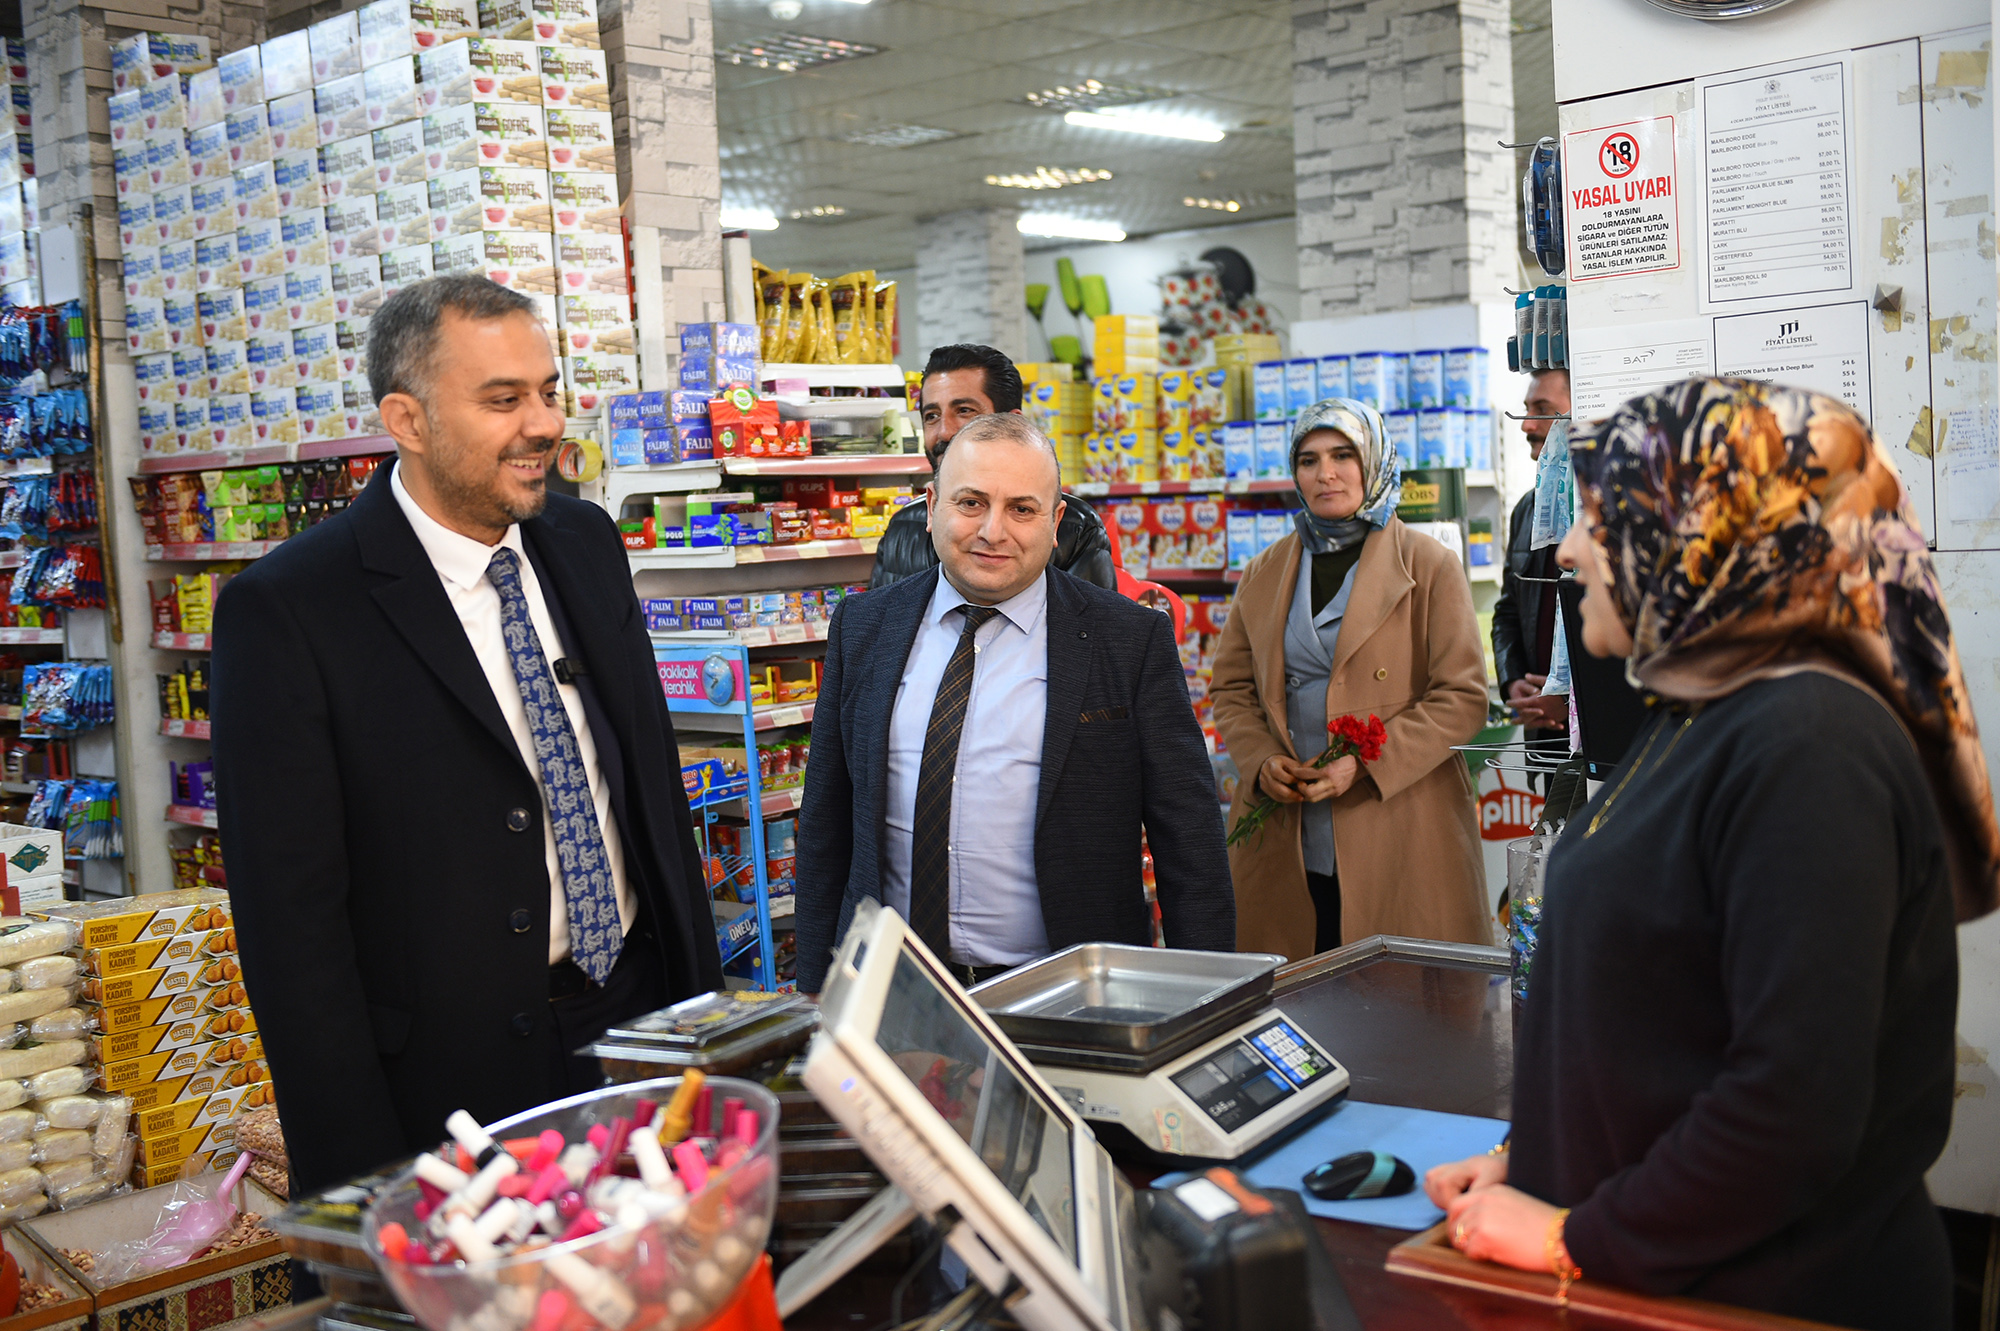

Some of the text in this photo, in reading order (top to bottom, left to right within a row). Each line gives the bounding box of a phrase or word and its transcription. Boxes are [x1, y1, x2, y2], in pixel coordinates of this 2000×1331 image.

[1711, 135, 1741, 145] MARLBORO
[1607, 141, 1631, 166] 18
[1711, 145, 1741, 154] MARLBORO
[1712, 161, 1760, 173] MARLBORO TOUCH
[1712, 174, 1742, 183] MARLBORO
[1572, 176, 1671, 209] YASAL UYARI
[1712, 185, 1745, 195] PARLIAMENT
[1712, 195, 1745, 204] PARLIAMENT
[1712, 205, 1745, 214] PARLIAMENT
[1746, 201, 1771, 209] MIDNIGHT
[1582, 214, 1663, 231] DOLDURMAYANLARA
[1577, 232, 1606, 242] SİGARA
[1618, 226, 1641, 236] DİĞER
[1644, 222, 1669, 232] TÜTÜN
[1580, 233, 1668, 251] ÜRÜNLERİ SATILAMAZ;
[1582, 244, 1667, 261] SATANLAR HAKKINDA
[1714, 252, 1753, 261] CHESTERFIELD
[1583, 260, 1607, 270] YASAL
[1608, 257, 1632, 268] İŞLEM
[1635, 254, 1667, 264] YAPILIR.
[1714, 275, 1744, 283] MARLBORO
[1786, 334, 1813, 344] LİSTESİ
[1623, 354, 1649, 364] BAT
[683, 370, 706, 379] FALIM
[1724, 369, 1752, 377] WINSTON
[614, 407, 638, 416] FALIM
[641, 405, 663, 414] FALIM
[647, 441, 670, 450] FALIM
[1400, 490, 1435, 500] COBS
[665, 531, 684, 539] POLO
[651, 602, 671, 611] FALIM
[693, 602, 714, 611] FALIM
[658, 617, 679, 627] FALIM
[702, 617, 723, 627] FALIM
[660, 664, 698, 680] dakikalık
[664, 680, 696, 695] ferahlık
[682, 770, 698, 780] RIBO
[89, 924, 118, 935] PORSİYON
[152, 923, 174, 932] HASTEL
[729, 919, 752, 941] ONEO
[90, 933, 118, 943] KADAYIF
[108, 948, 136, 959] PORSİYON
[170, 946, 191, 955] HASTEL
[109, 957, 136, 968] KADAYIF
[105, 980, 133, 991] PORSİYON
[166, 977, 187, 986] HASTEL
[106, 989, 133, 1000] KADAYIF
[174, 1000, 195, 1010] HASTEL
[114, 1005, 141, 1016] PORSİYON
[114, 1013, 140, 1024] KADAYIF
[172, 1028, 194, 1038] HASTEL
[111, 1033, 138, 1044] PORSİYON
[112, 1042, 138, 1052] KADAYIF
[174, 1058, 196, 1067] HASTEL
[112, 1063, 140, 1074] PORSİYON
[112, 1071, 139, 1083] KADAYIF
[192, 1081, 212, 1091] HASTEL
[130, 1086, 158, 1098] PORSİYON
[208, 1104, 229, 1113] HASTEL
[147, 1110, 175, 1122] PORSİYON
[148, 1118, 175, 1131] KADAYIF
[152, 1136, 180, 1148] PORSİYON
[153, 1146, 180, 1158] KADAYIF
[215, 1157, 235, 1167] HASTEL
